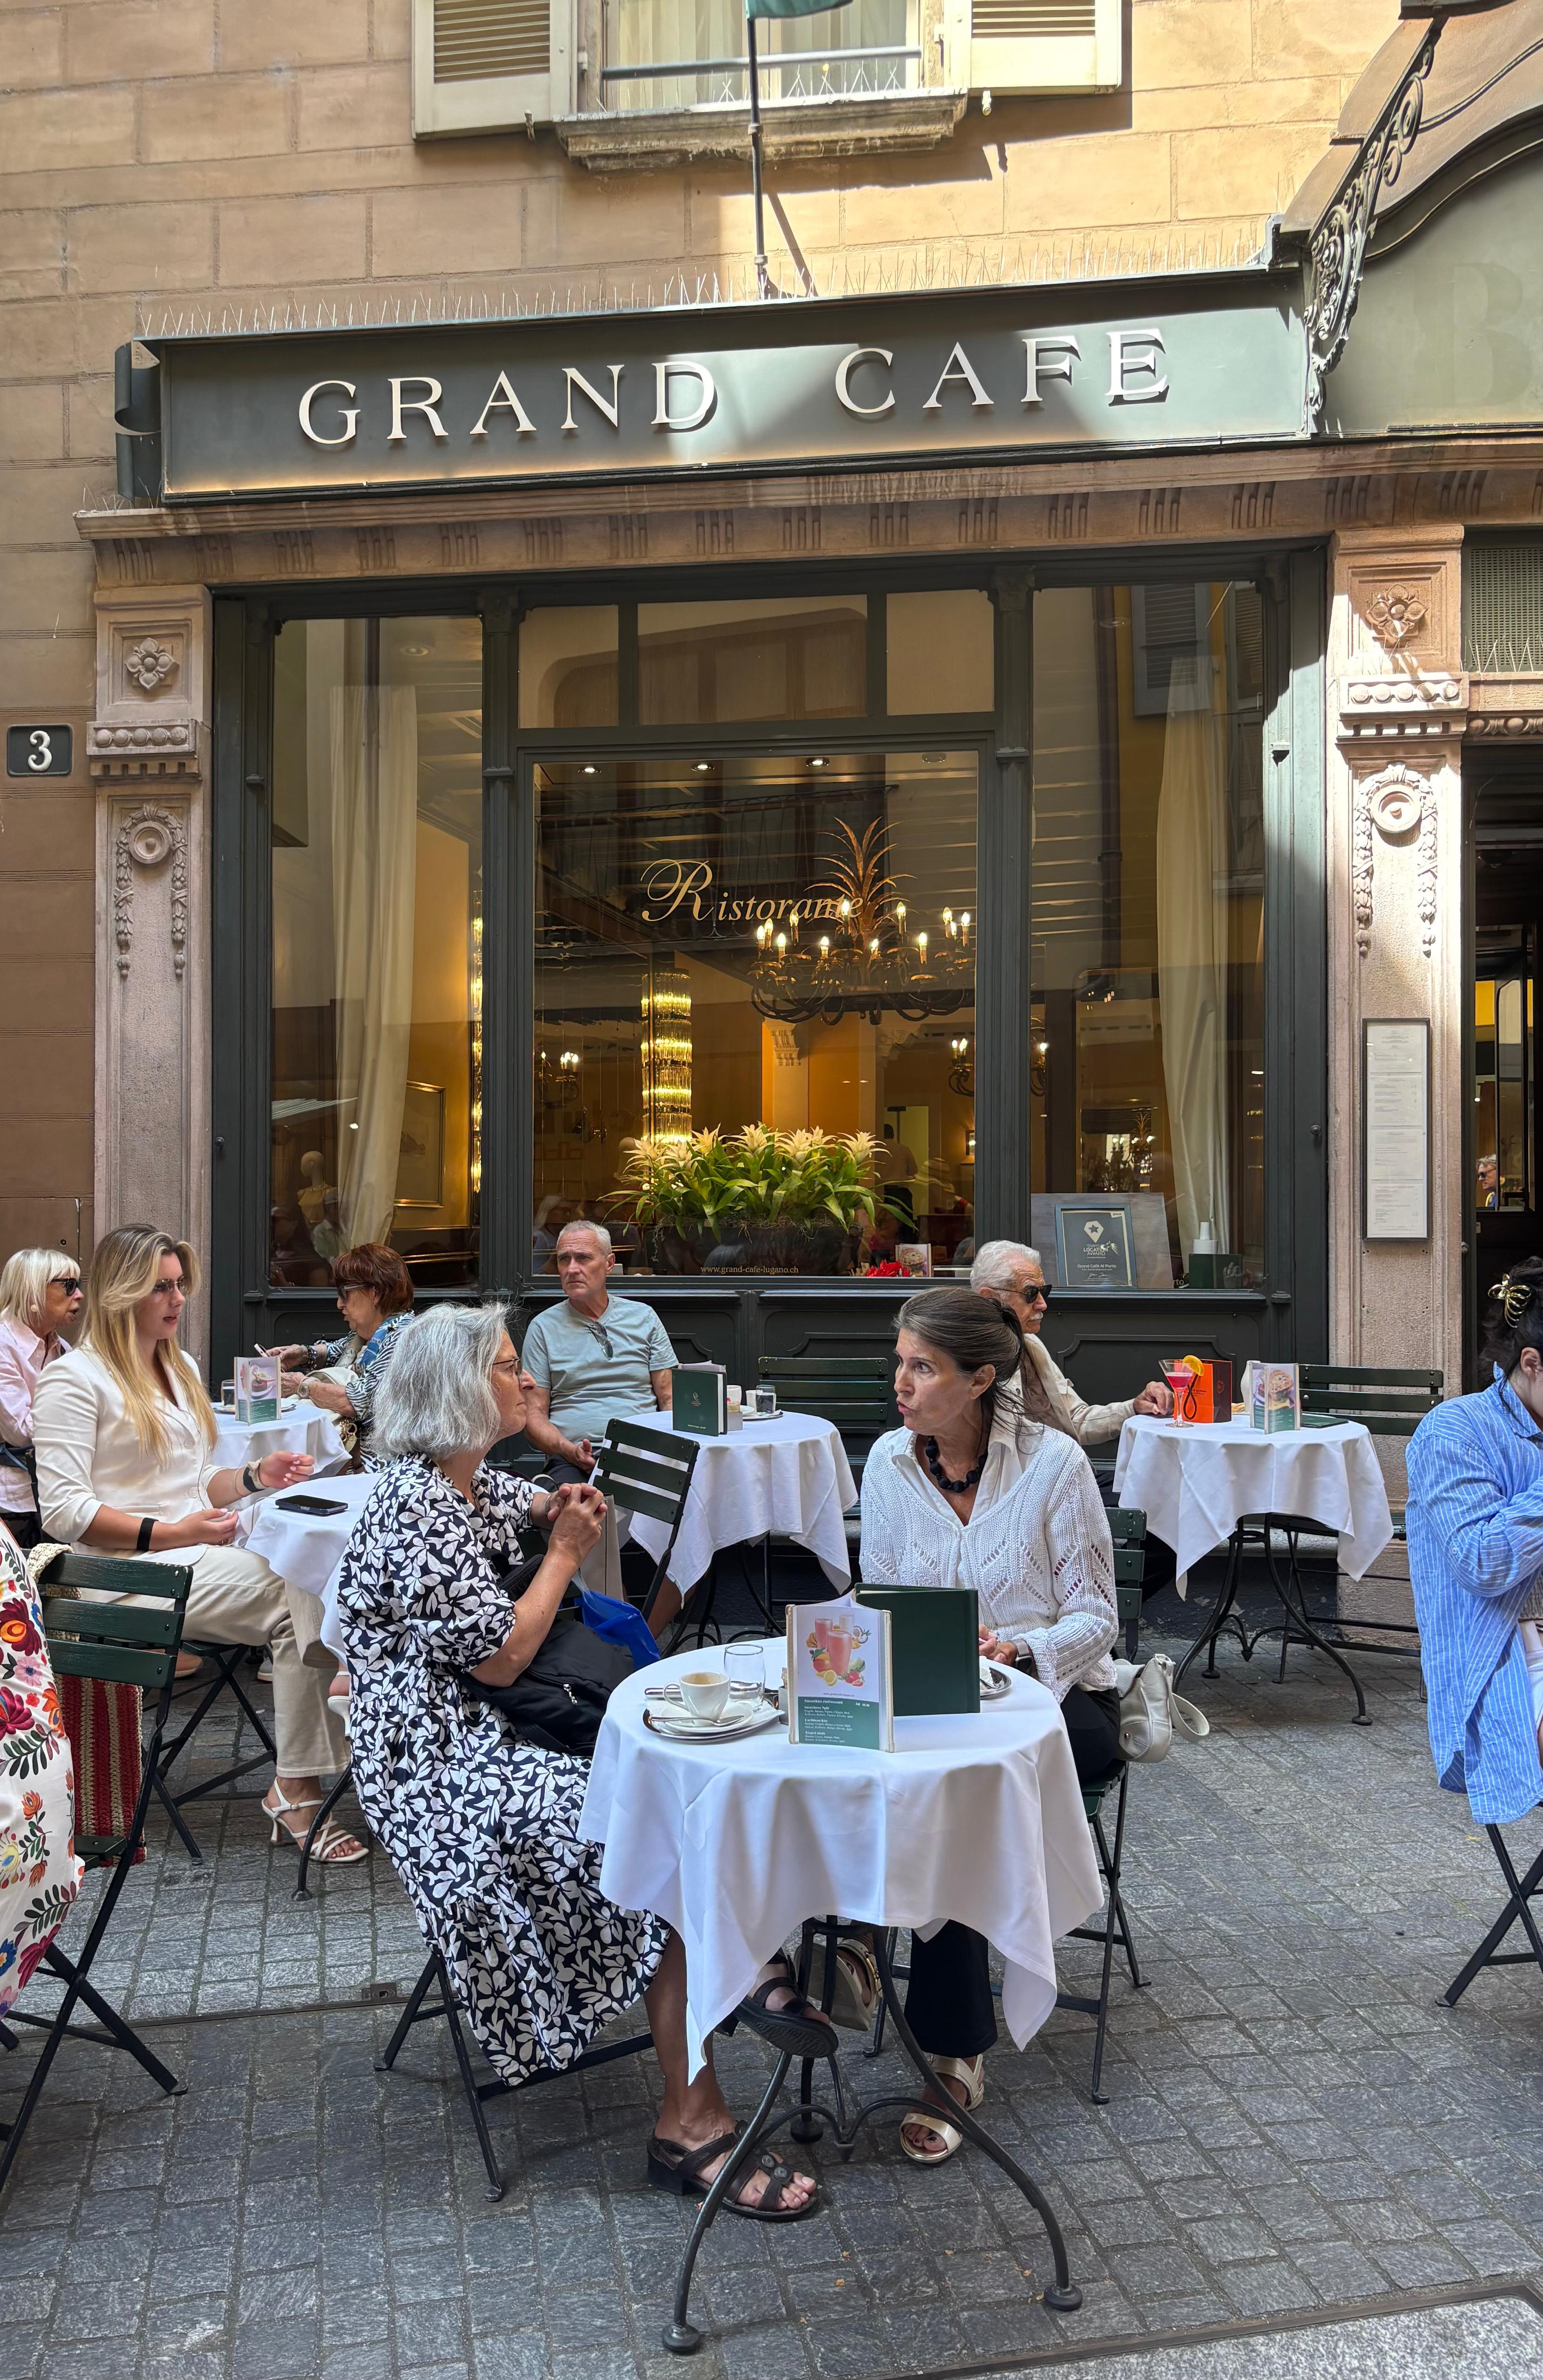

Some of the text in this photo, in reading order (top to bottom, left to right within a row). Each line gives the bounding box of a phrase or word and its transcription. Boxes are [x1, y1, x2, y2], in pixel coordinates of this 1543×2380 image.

[299, 328, 1168, 444] GRAND CAFE
[28, 730, 52, 772] 3
[640, 859, 863, 922] Ristorante
[700, 1265, 799, 1275] www.grand-cafe-lugano.ch
